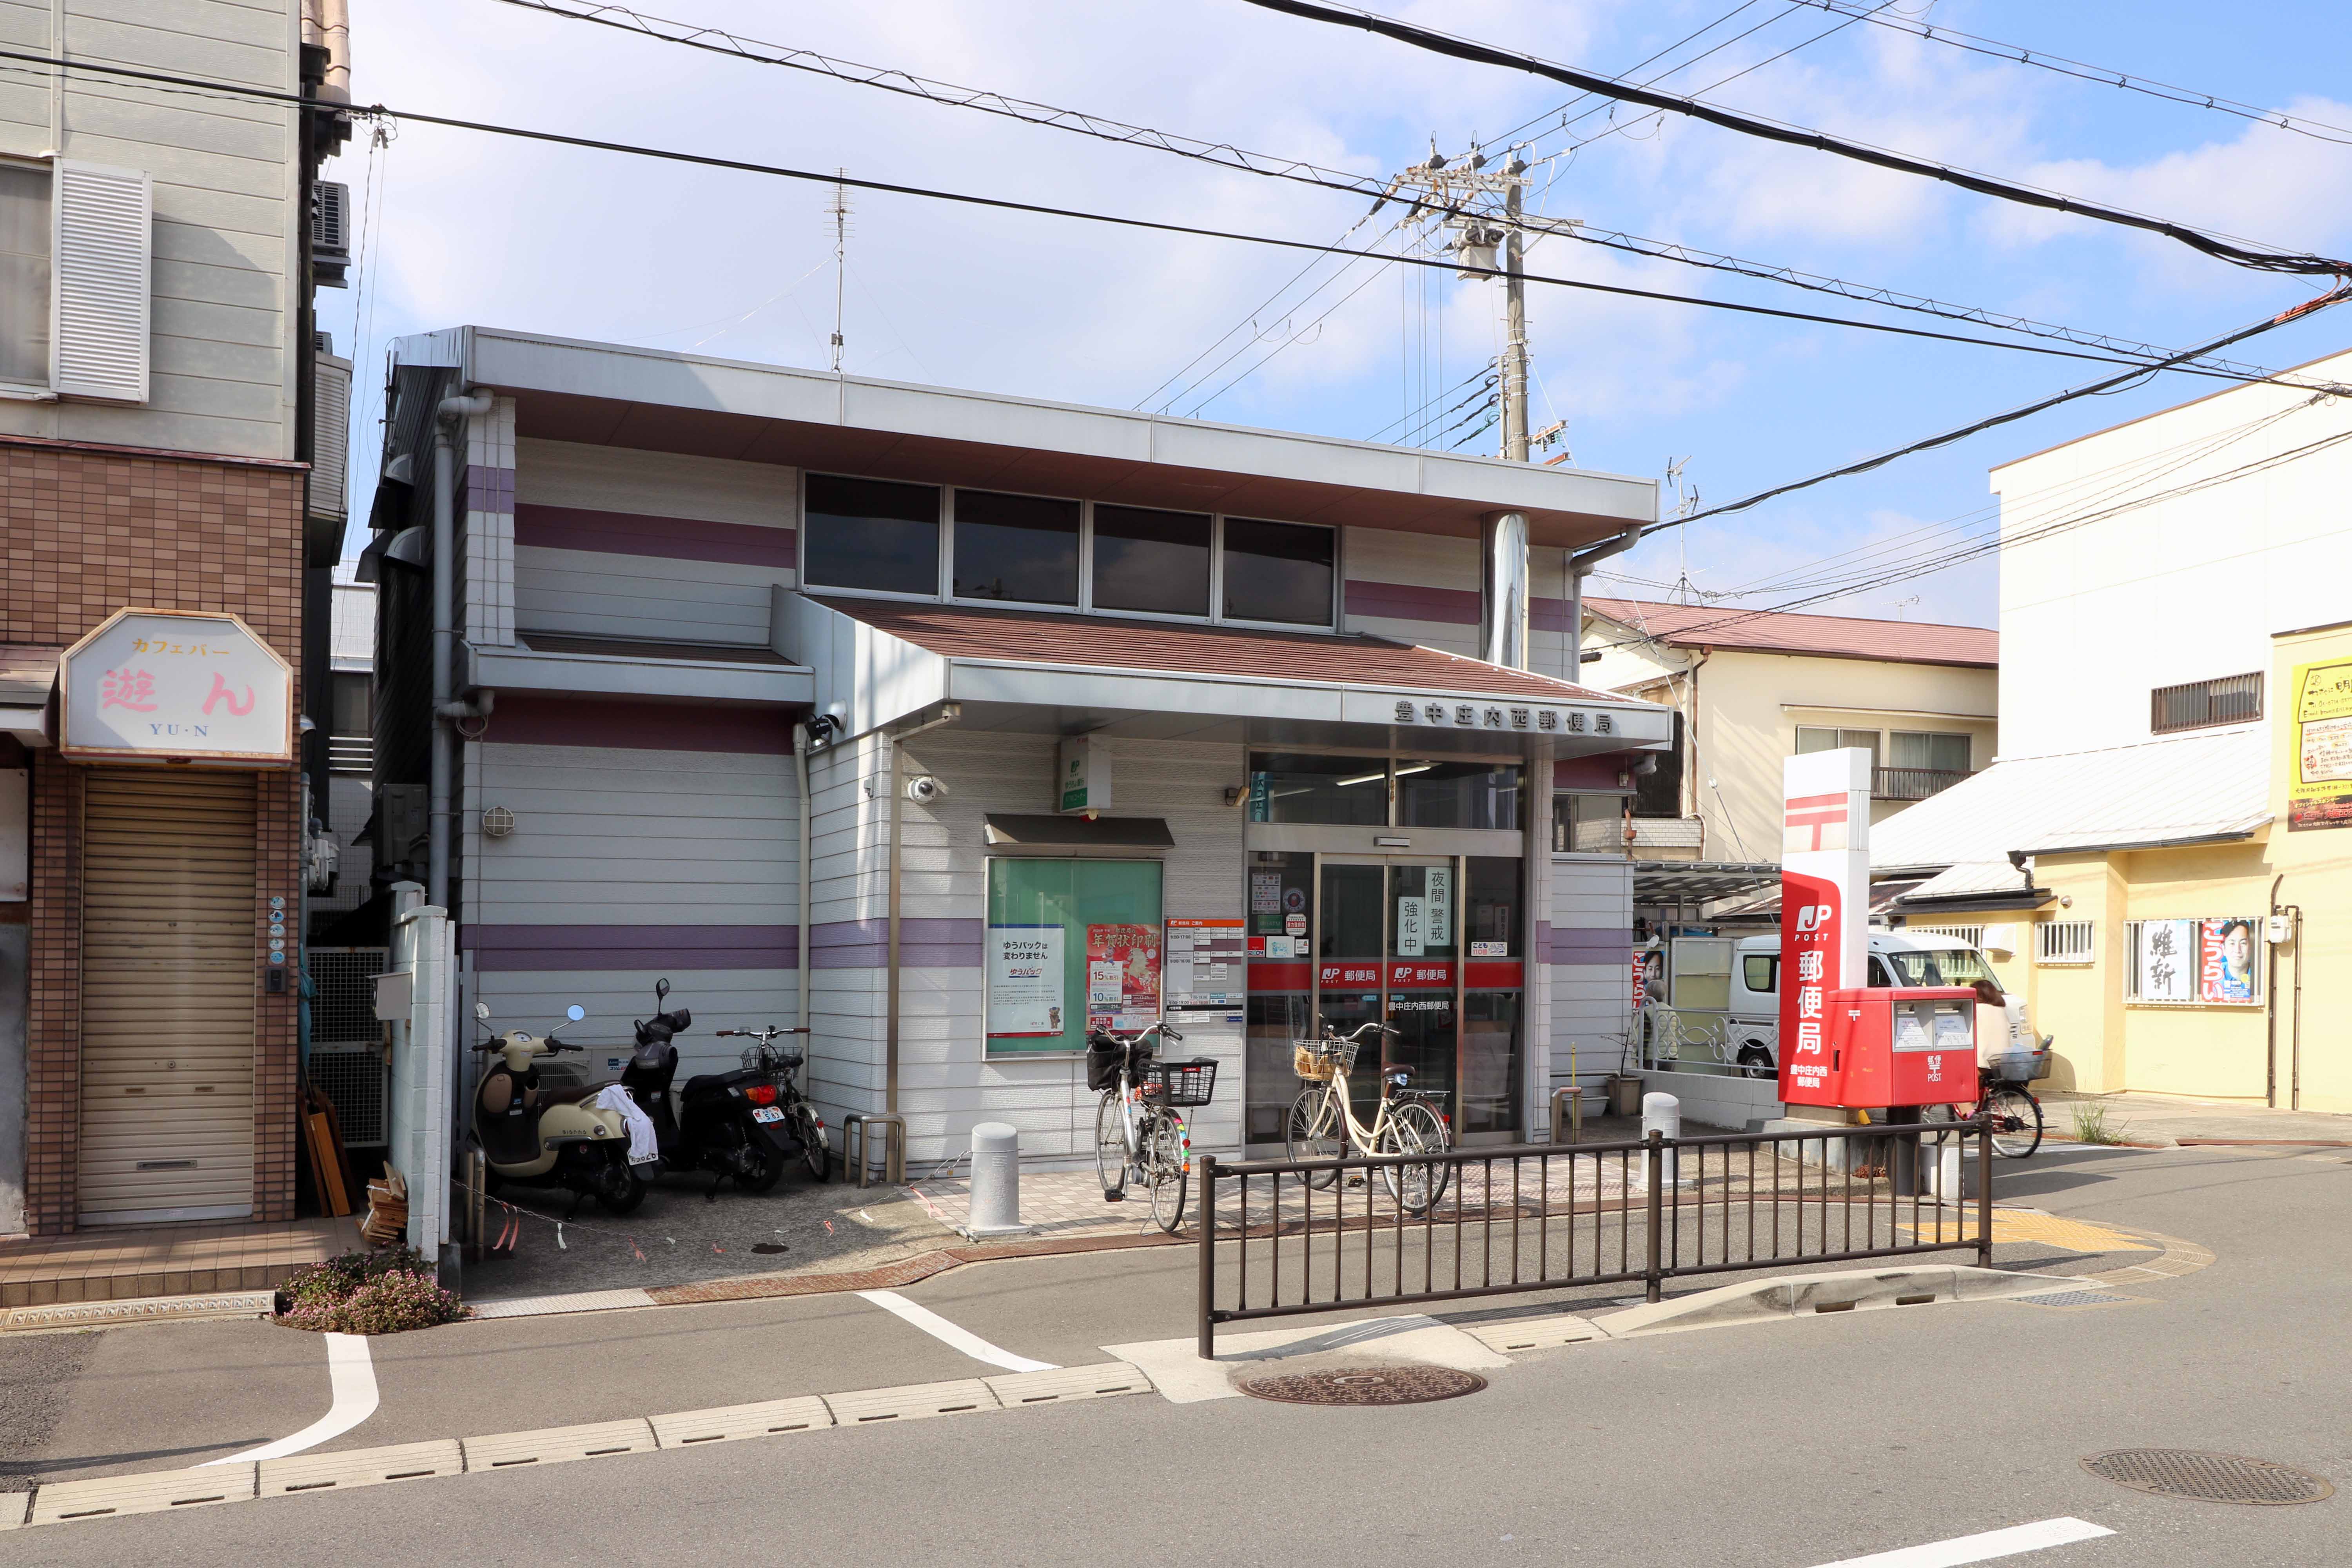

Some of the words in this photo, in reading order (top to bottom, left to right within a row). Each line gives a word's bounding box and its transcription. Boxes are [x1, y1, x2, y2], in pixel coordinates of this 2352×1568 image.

[132, 638, 230, 656] カフェバー
[2335, 679, 2352, 693] 明
[1395, 701, 1612, 732] 豊中庄内西郵便局
[1431, 871, 1445, 940] 夜間警戒
[1796, 905, 1832, 932] JP
[1404, 902, 1418, 952] 強化中
[1092, 933, 1156, 948] 年賀状印刷
[1795, 933, 1829, 941] POST
[2150, 923, 2177, 995] 維新
[2202, 922, 2225, 1000] こうらい
[1010, 967, 1042, 975] ゆうパック
[1322, 968, 1340, 979] JP
[1344, 970, 1376, 981] 郵便局
[1394, 967, 1412, 978] JP
[1416, 969, 1447, 980] 郵便局
[1388, 1001, 1449, 1011] 豊中庄内西郵便局
[1797, 950, 1824, 1055] 郵便局
[1927, 1055, 1942, 1065] 郵便
[1789, 1064, 1828, 1077] 豊中庄内西
[1797, 1076, 1820, 1088] 郵便局
[1928, 1073, 1942, 1082] POST
